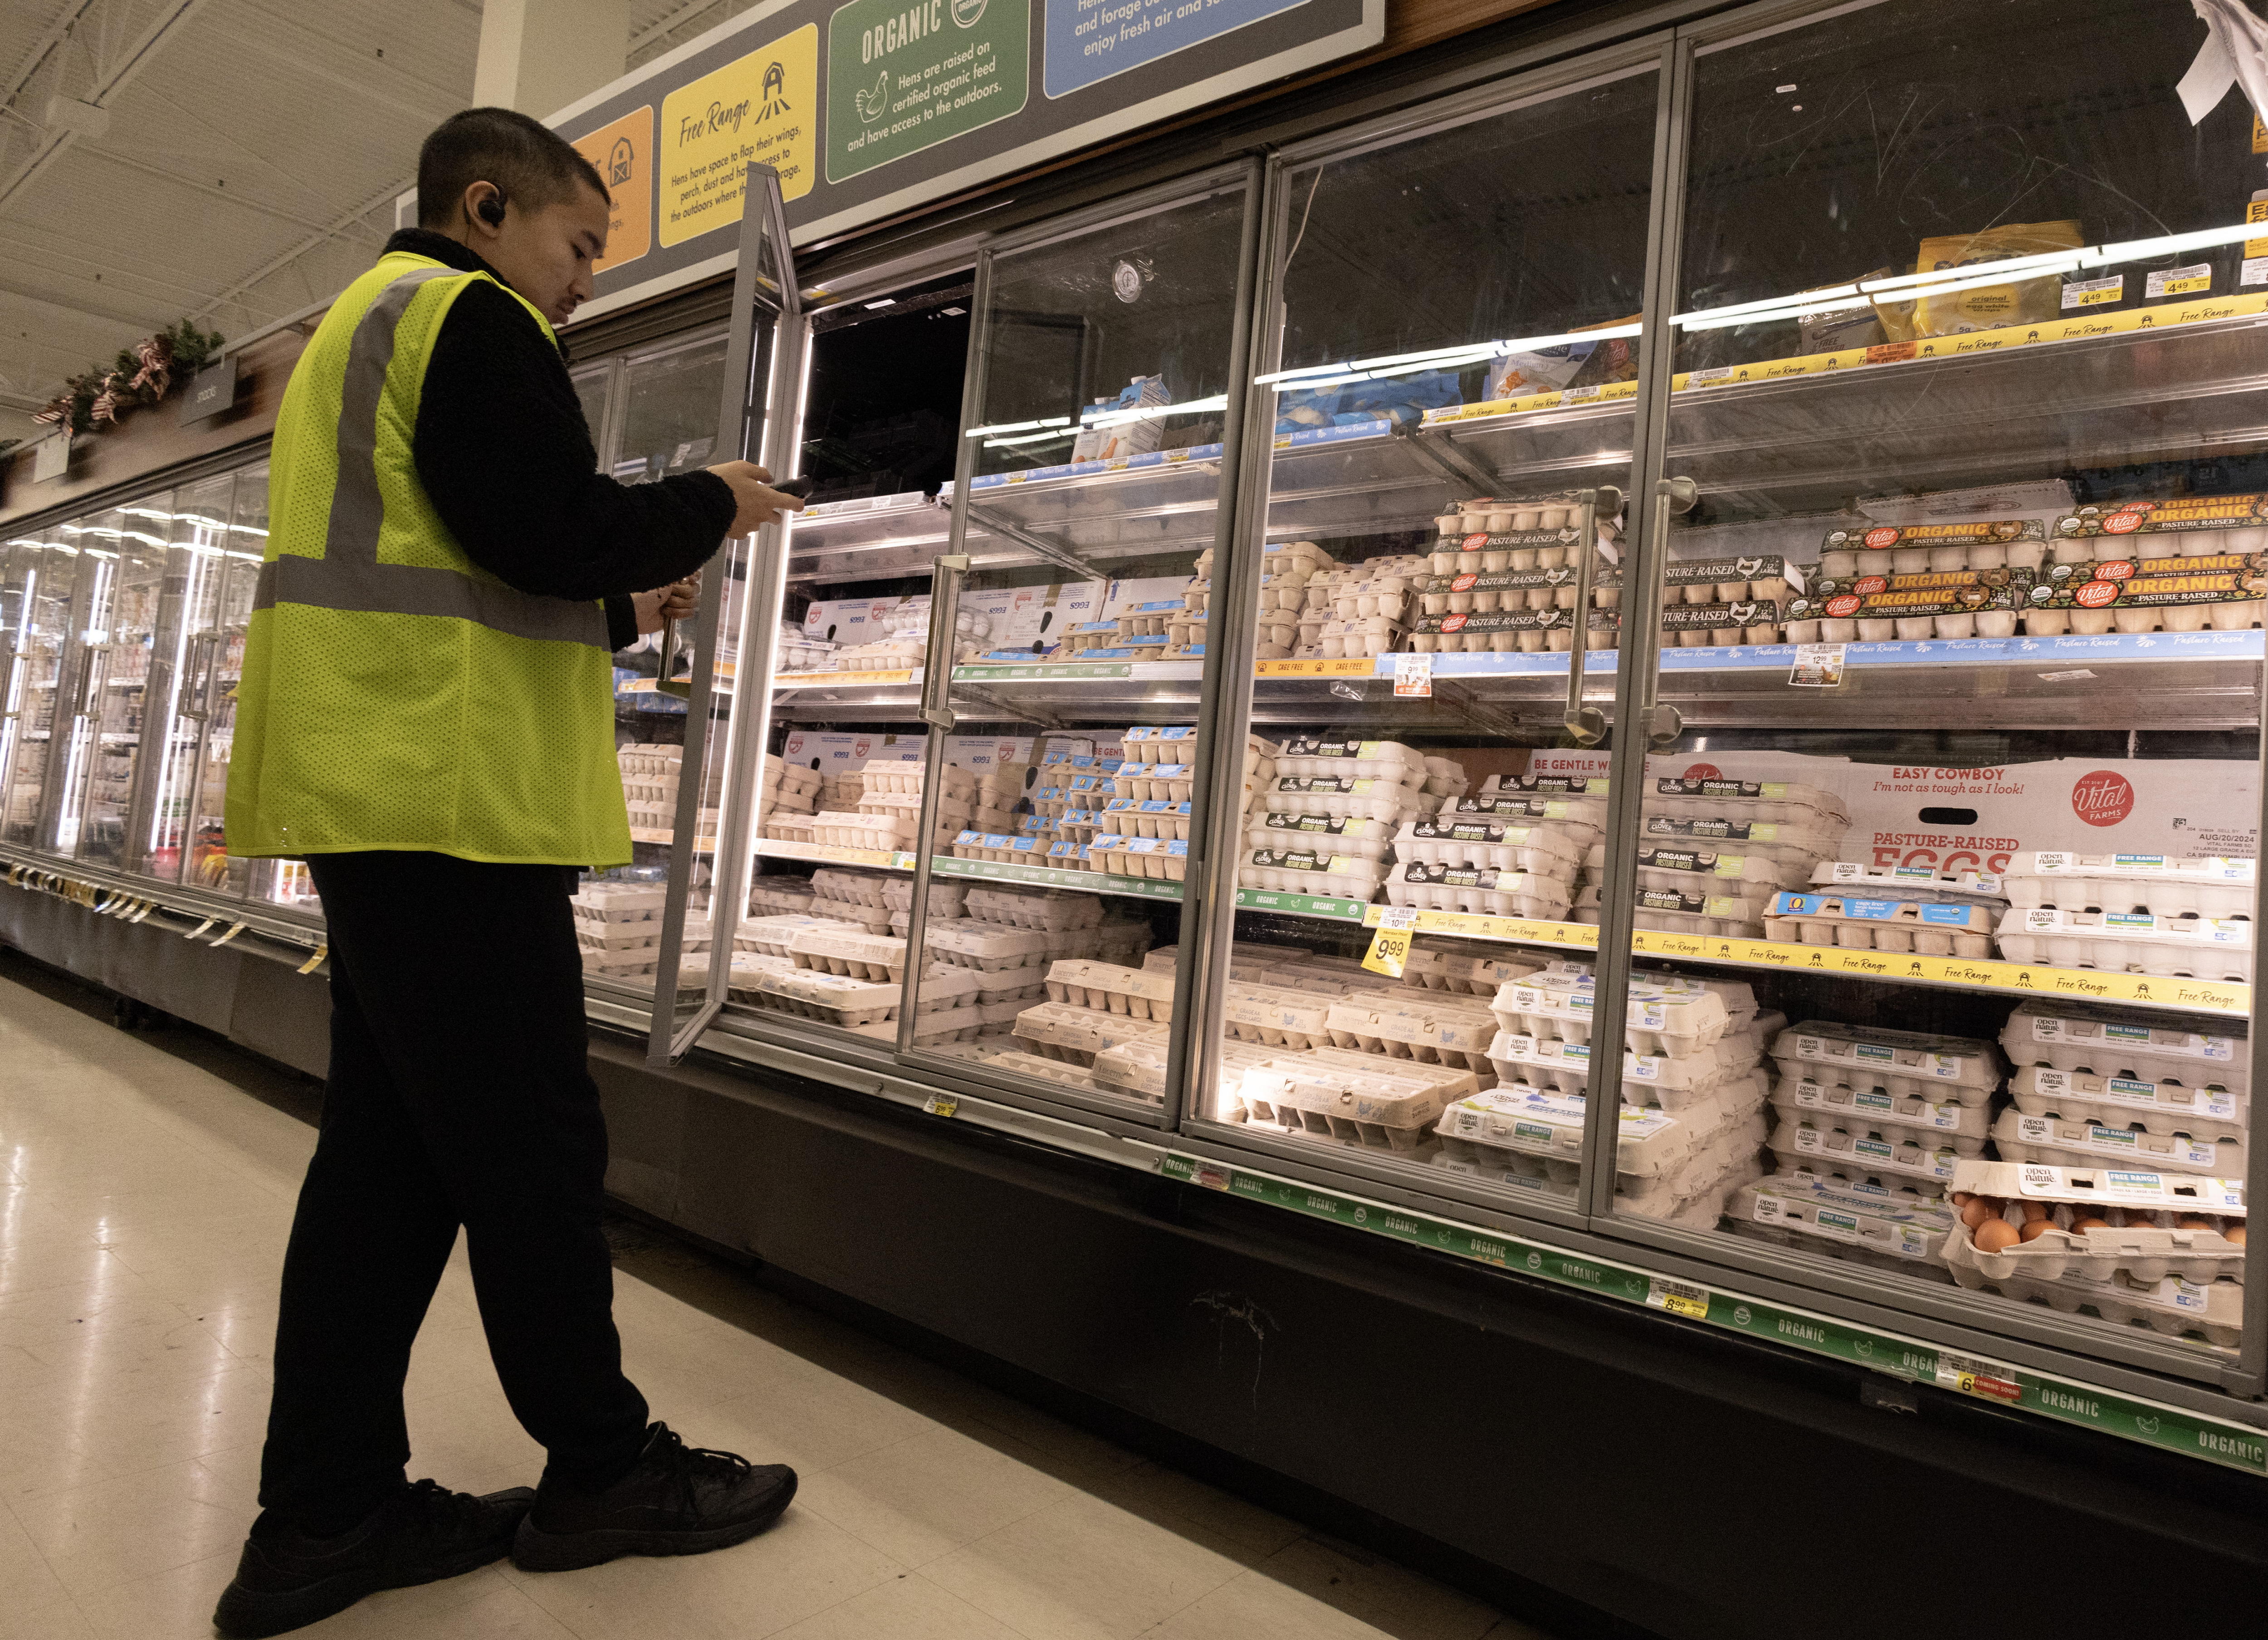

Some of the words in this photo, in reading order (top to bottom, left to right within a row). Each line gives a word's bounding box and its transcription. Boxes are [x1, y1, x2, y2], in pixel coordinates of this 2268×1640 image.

[1075, 14, 1097, 37] and
[1101, 1, 1141, 26] forage
[862, 0, 941, 64] ORGANIC
[1084, 34, 1117, 56] enjoy
[1120, 14, 1150, 42] fresh
[1155, 9, 1173, 28] air
[1177, 0, 1201, 19] and
[899, 73, 921, 90] Hens
[924, 65, 940, 79] are
[943, 43, 973, 70] raised
[977, 42, 990, 56] on
[893, 83, 930, 113] certified
[933, 71, 970, 95] organic
[973, 55, 996, 80] feed
[679, 116, 705, 147] Free
[706, 99, 750, 134] Range
[848, 132, 864, 152] and
[867, 126, 889, 144] have
[892, 114, 921, 134] access
[924, 108, 933, 122] to
[936, 100, 951, 117] the
[954, 82, 1002, 108] outdoors.
[671, 170, 688, 187] Hens
[690, 165, 707, 181] have
[709, 156, 729, 173] space
[731, 153, 738, 162] to
[740, 142, 754, 160] flap
[757, 136, 774, 151] their
[776, 125, 802, 142] wings,
[680, 185, 702, 205] perch,
[704, 179, 719, 193] dust
[720, 172, 734, 185] and
[736, 165, 748, 179] hav
[757, 154, 780, 166] ccess
[782, 148, 790, 158] to
[670, 211, 681, 223] the
[683, 197, 713, 218] outdoors
[715, 187, 738, 205] where
[2180, 312, 2200, 322] Free
[2202, 308, 2235, 319] Range
[1957, 342, 1975, 351] Free
[1976, 339, 2003, 350] Range
[2151, 505, 2248, 521] ORGANIC
[2104, 514, 2137, 528] Vital
[2161, 519, 2235, 528] PASTURE-RAISED
[1906, 524, 1987, 537] ORGANIC
[2143, 556, 2242, 571] ORGANIC
[1666, 566, 1735, 577] STURE-RAISED
[1453, 575, 1476, 588] Vital
[1475, 575, 1544, 586] PASTURE-RAISED
[2128, 576, 2232, 593] ORGANIC
[1868, 590, 1953, 606] ORGANIC
[2077, 583, 2112, 602] Vital
[2138, 591, 2218, 601] PASTURE-RAISED
[1827, 598, 1857, 611] Vital
[2087, 597, 2110, 605] FARMS
[1662, 611, 1728, 622] TURE-RAISED
[1876, 605, 1941, 614] PASTURE-RAISED
[2173, 635, 2209, 645] Pasture
[2210, 635, 2245, 644] Raised
[1669, 649, 1693, 658] Pasture
[1847, 644, 1874, 654] Pasture
[1875, 644, 1902, 652] Raised
[1535, 759, 1549, 769] BE
[1551, 760, 1593, 771] GENTLE
[1893, 767, 1930, 779] EASY
[1934, 768, 2005, 781] COWBOY
[1873, 781, 1891, 791] I'm
[1894, 783, 1913, 792] not
[1932, 784, 1966, 795] tough
[1985, 784, 1991, 793] I
[1994, 784, 2024, 795] look!
[2074, 779, 2126, 811] Vital
[2090, 809, 2121, 820] FARMS
[1873, 833, 2019, 851] PASTURE-RAISED
[2199, 834, 2254, 843] AUG/20/2024
[1287, 854, 1314, 863] ORGANIC
[1872, 847, 2012, 875] EGGS
[1256, 895, 1278, 905] ORGANIC
[1945, 967, 1962, 978] Free
[1964, 969, 1992, 983] Range
[1518, 990, 1534, 999] open
[2042, 1072, 2063, 1080] open
[1516, 1123, 1530, 1132] FREE
[1531, 1125, 1551, 1135] RANGE
[2025, 1174, 2054, 1182] nature
[2026, 1167, 2051, 1176] open
[1307, 1196, 1336, 1213] ORGANIC
[1778, 1319, 1824, 1343] ORGANIC
[1975, 1380, 1998, 1392] COMING
[2000, 1385, 2019, 1396] SOON!
[2199, 1431, 2263, 1463] ORGANIC
